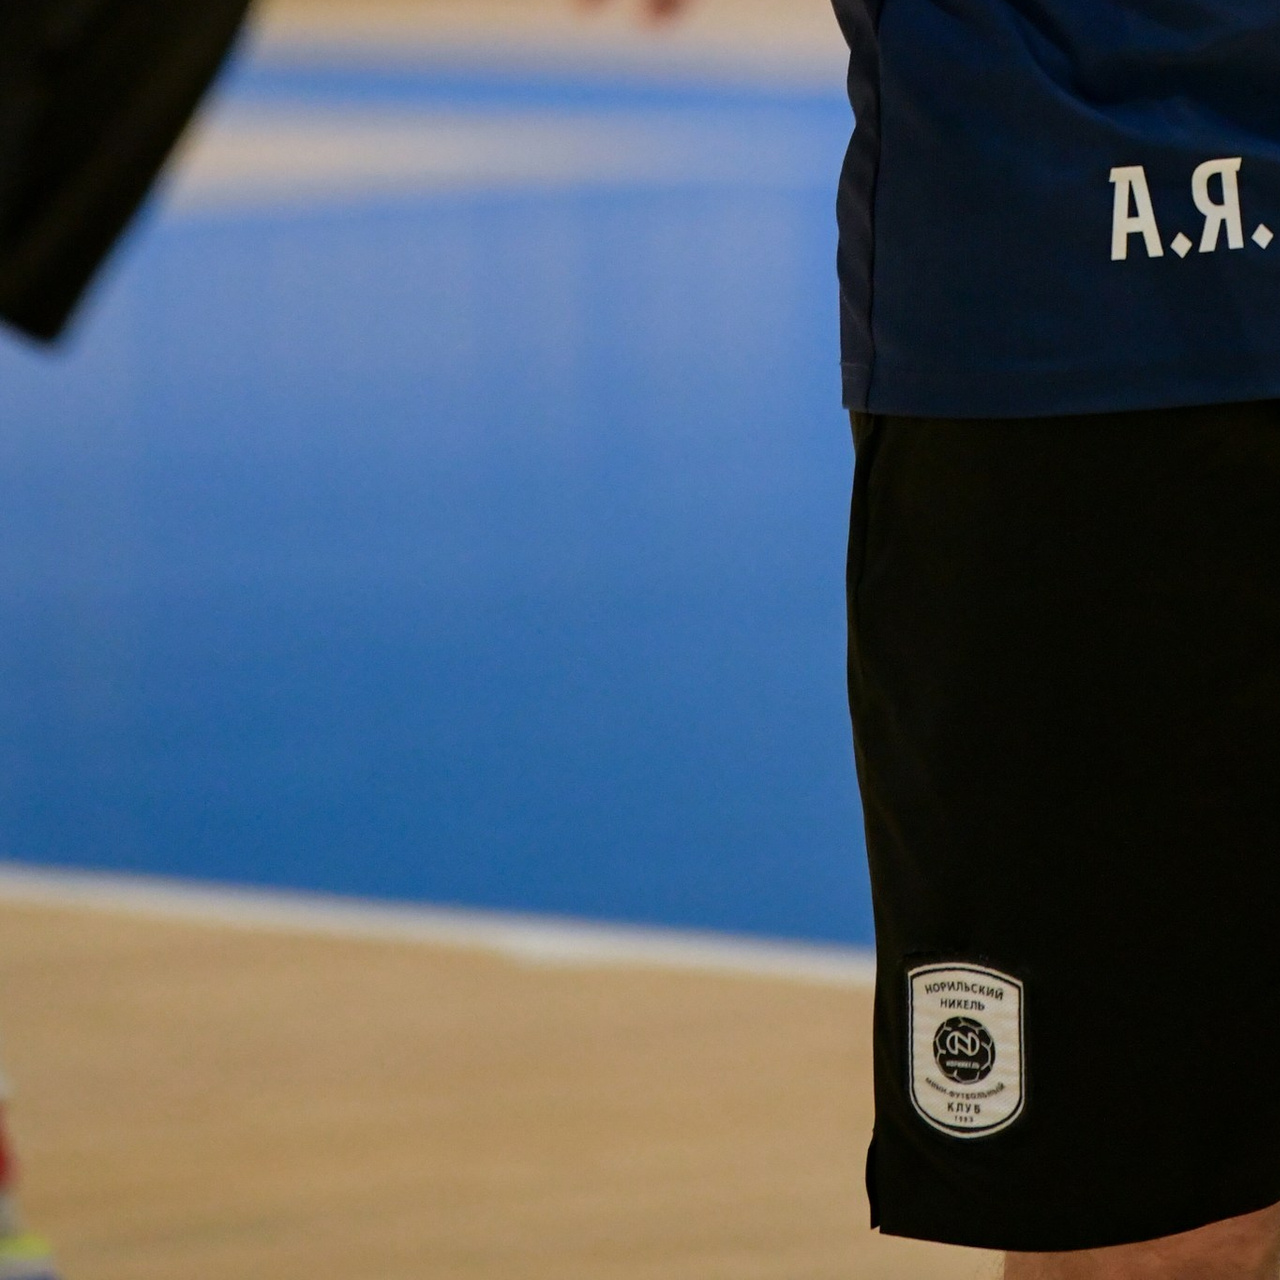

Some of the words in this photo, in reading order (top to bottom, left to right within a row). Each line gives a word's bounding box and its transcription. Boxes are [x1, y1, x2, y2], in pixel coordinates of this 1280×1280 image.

[924, 980, 1004, 1001] НОРИЛЬСКИЙ
[940, 997, 985, 1011] НИКЕЛЬ
[947, 1102, 981, 1114] КЛУБ
